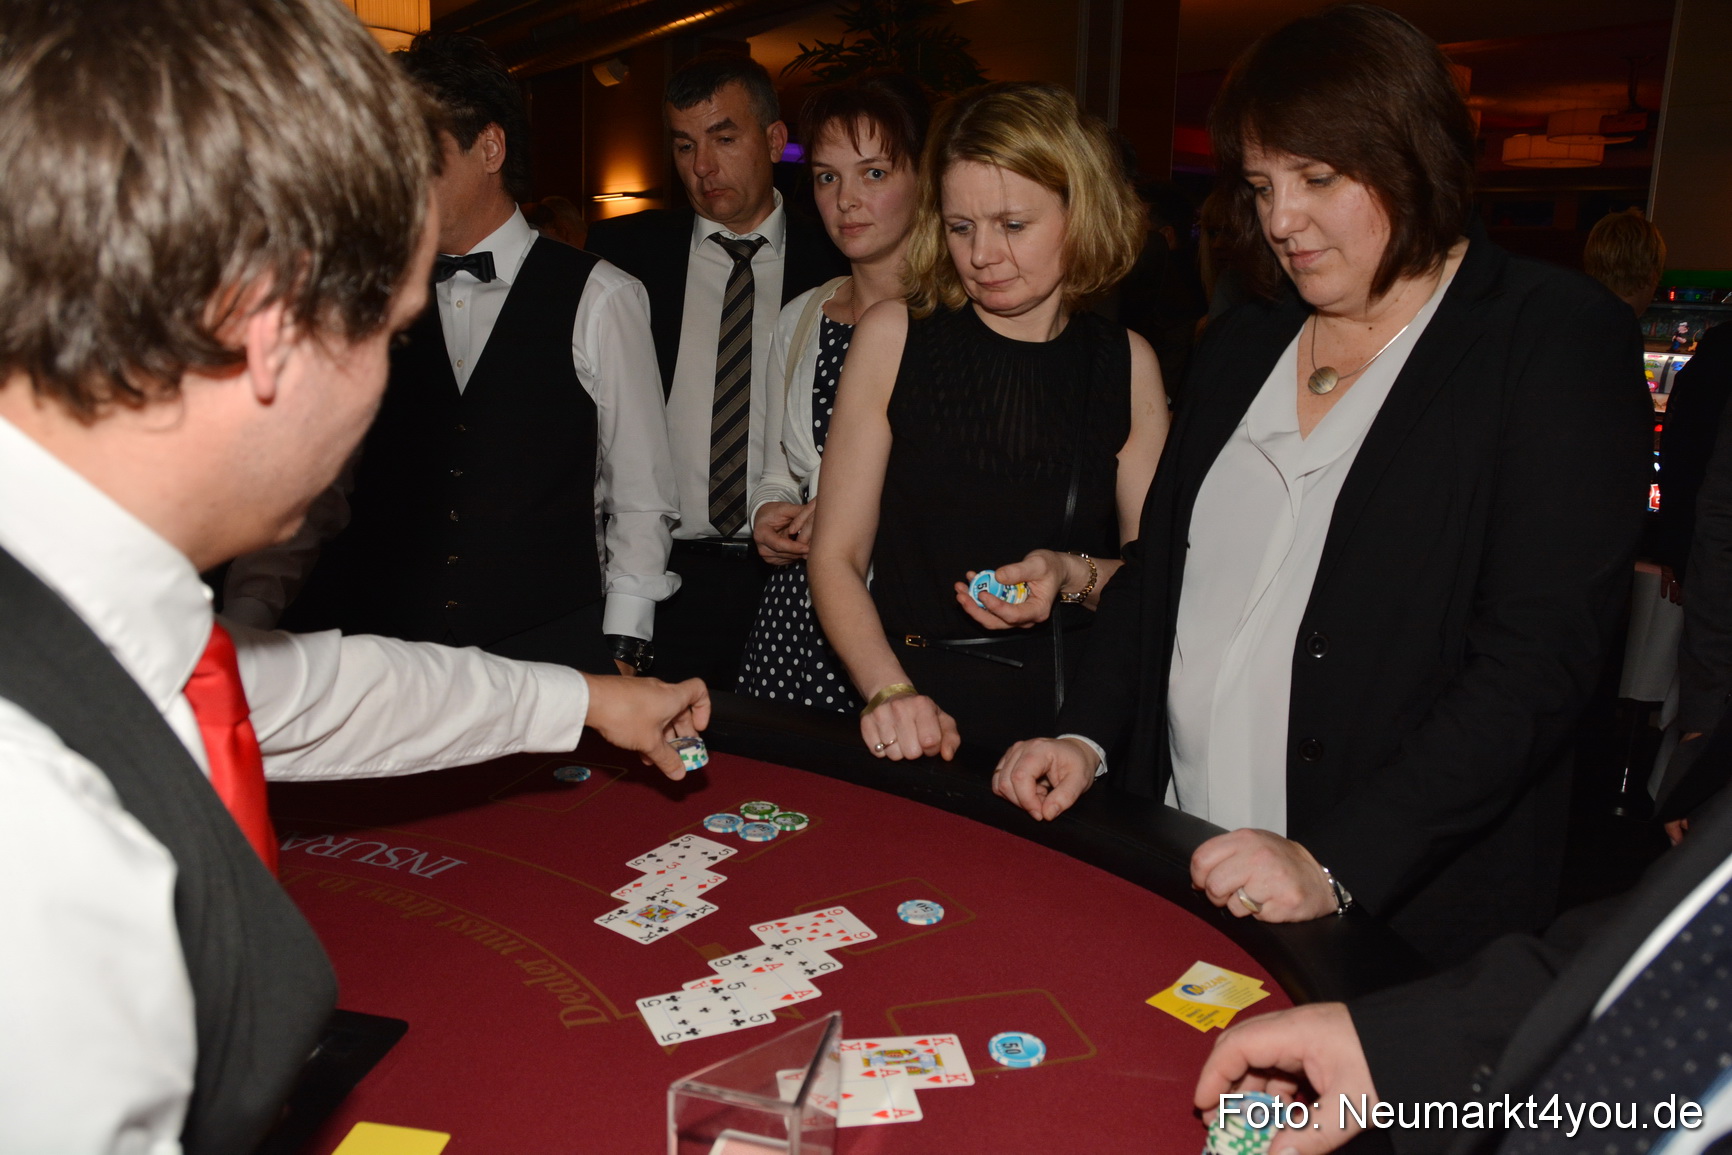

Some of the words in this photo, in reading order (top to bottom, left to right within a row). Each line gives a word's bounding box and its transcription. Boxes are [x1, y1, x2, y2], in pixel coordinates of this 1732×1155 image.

[680, 835, 695, 843] 5
[277, 830, 468, 880] INSURA
[718, 848, 733, 856] 5
[631, 858, 646, 867] 5
[666, 862, 682, 870] 3
[707, 875, 723, 884] 3
[616, 888, 632, 897] 3
[655, 887, 675, 897] K
[695, 904, 715, 914] K
[599, 914, 619, 924] K
[434, 913, 527, 957] must
[638, 931, 660, 942] K
[765, 962, 785, 973] A
[690, 980, 709, 990] A
[727, 980, 747, 991] 5
[513, 958, 610, 1029] Dealer
[794, 989, 814, 999] A
[641, 998, 662, 1009] 5
[749, 1013, 771, 1023] 5
[661, 1031, 682, 1042] 5
[840, 1042, 862, 1052] K
[932, 1037, 955, 1047] K
[1002, 1042, 1022, 1055] 50
[880, 1068, 902, 1078] A
[946, 1073, 969, 1083] K
[892, 1108, 916, 1119] A
